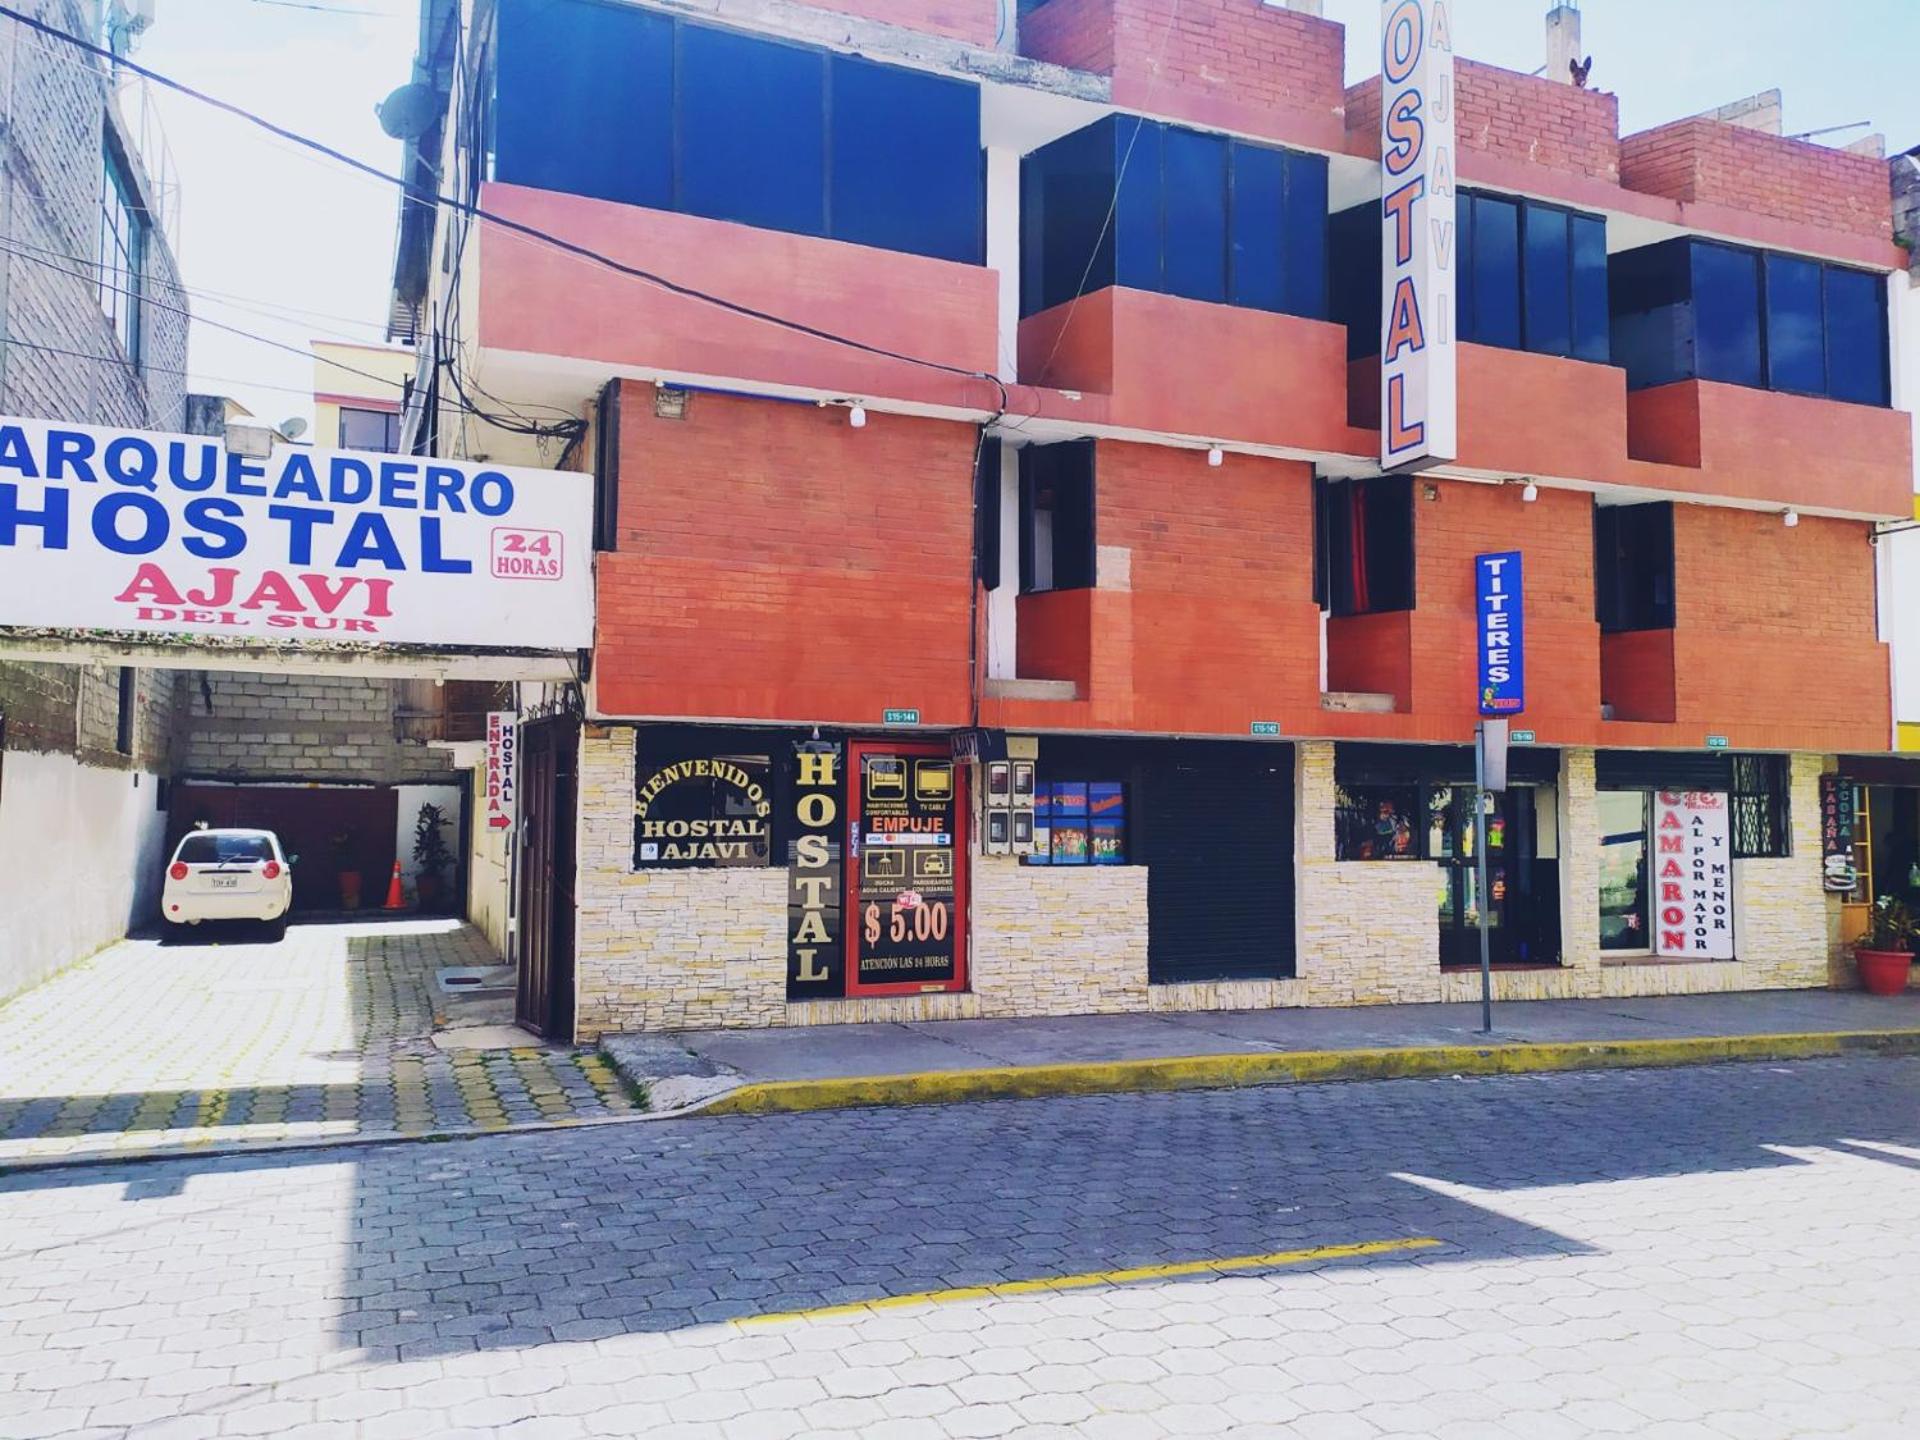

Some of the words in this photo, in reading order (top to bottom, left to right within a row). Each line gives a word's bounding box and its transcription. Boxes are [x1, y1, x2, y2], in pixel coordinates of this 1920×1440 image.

[1428, 0, 1453, 344] AJAVI
[1383, 0, 1424, 454] OSTAL
[0, 483, 472, 574] HOSTAL
[501, 533, 552, 557] 24
[114, 562, 393, 617] AJAVI
[497, 556, 558, 576] HORAS
[137, 606, 249, 626] DEL
[266, 615, 379, 633] SUR
[1484, 559, 1511, 683] TITERES
[489, 715, 500, 811] ENTRADA
[502, 725, 513, 802] HOSTAL
[635, 759, 770, 819] BIENVENIDOS
[641, 819, 765, 838] HOSTAL
[661, 842, 748, 860] AJAVI
[872, 817, 944, 833] EMPUJE
[1692, 815, 1704, 837] AL
[1712, 837, 1723, 847] Y
[792, 753, 837, 981] HOSTAL
[1659, 790, 1685, 950] CAMARON
[1693, 847, 1705, 881] POR
[1693, 890, 1707, 950] MAYOR
[1712, 864, 1726, 929] MENOR
[865, 900, 880, 950] $
[890, 901, 948, 942] 5.00
[899, 957, 913, 969] LAS
[924, 955, 949, 967] HORAS
